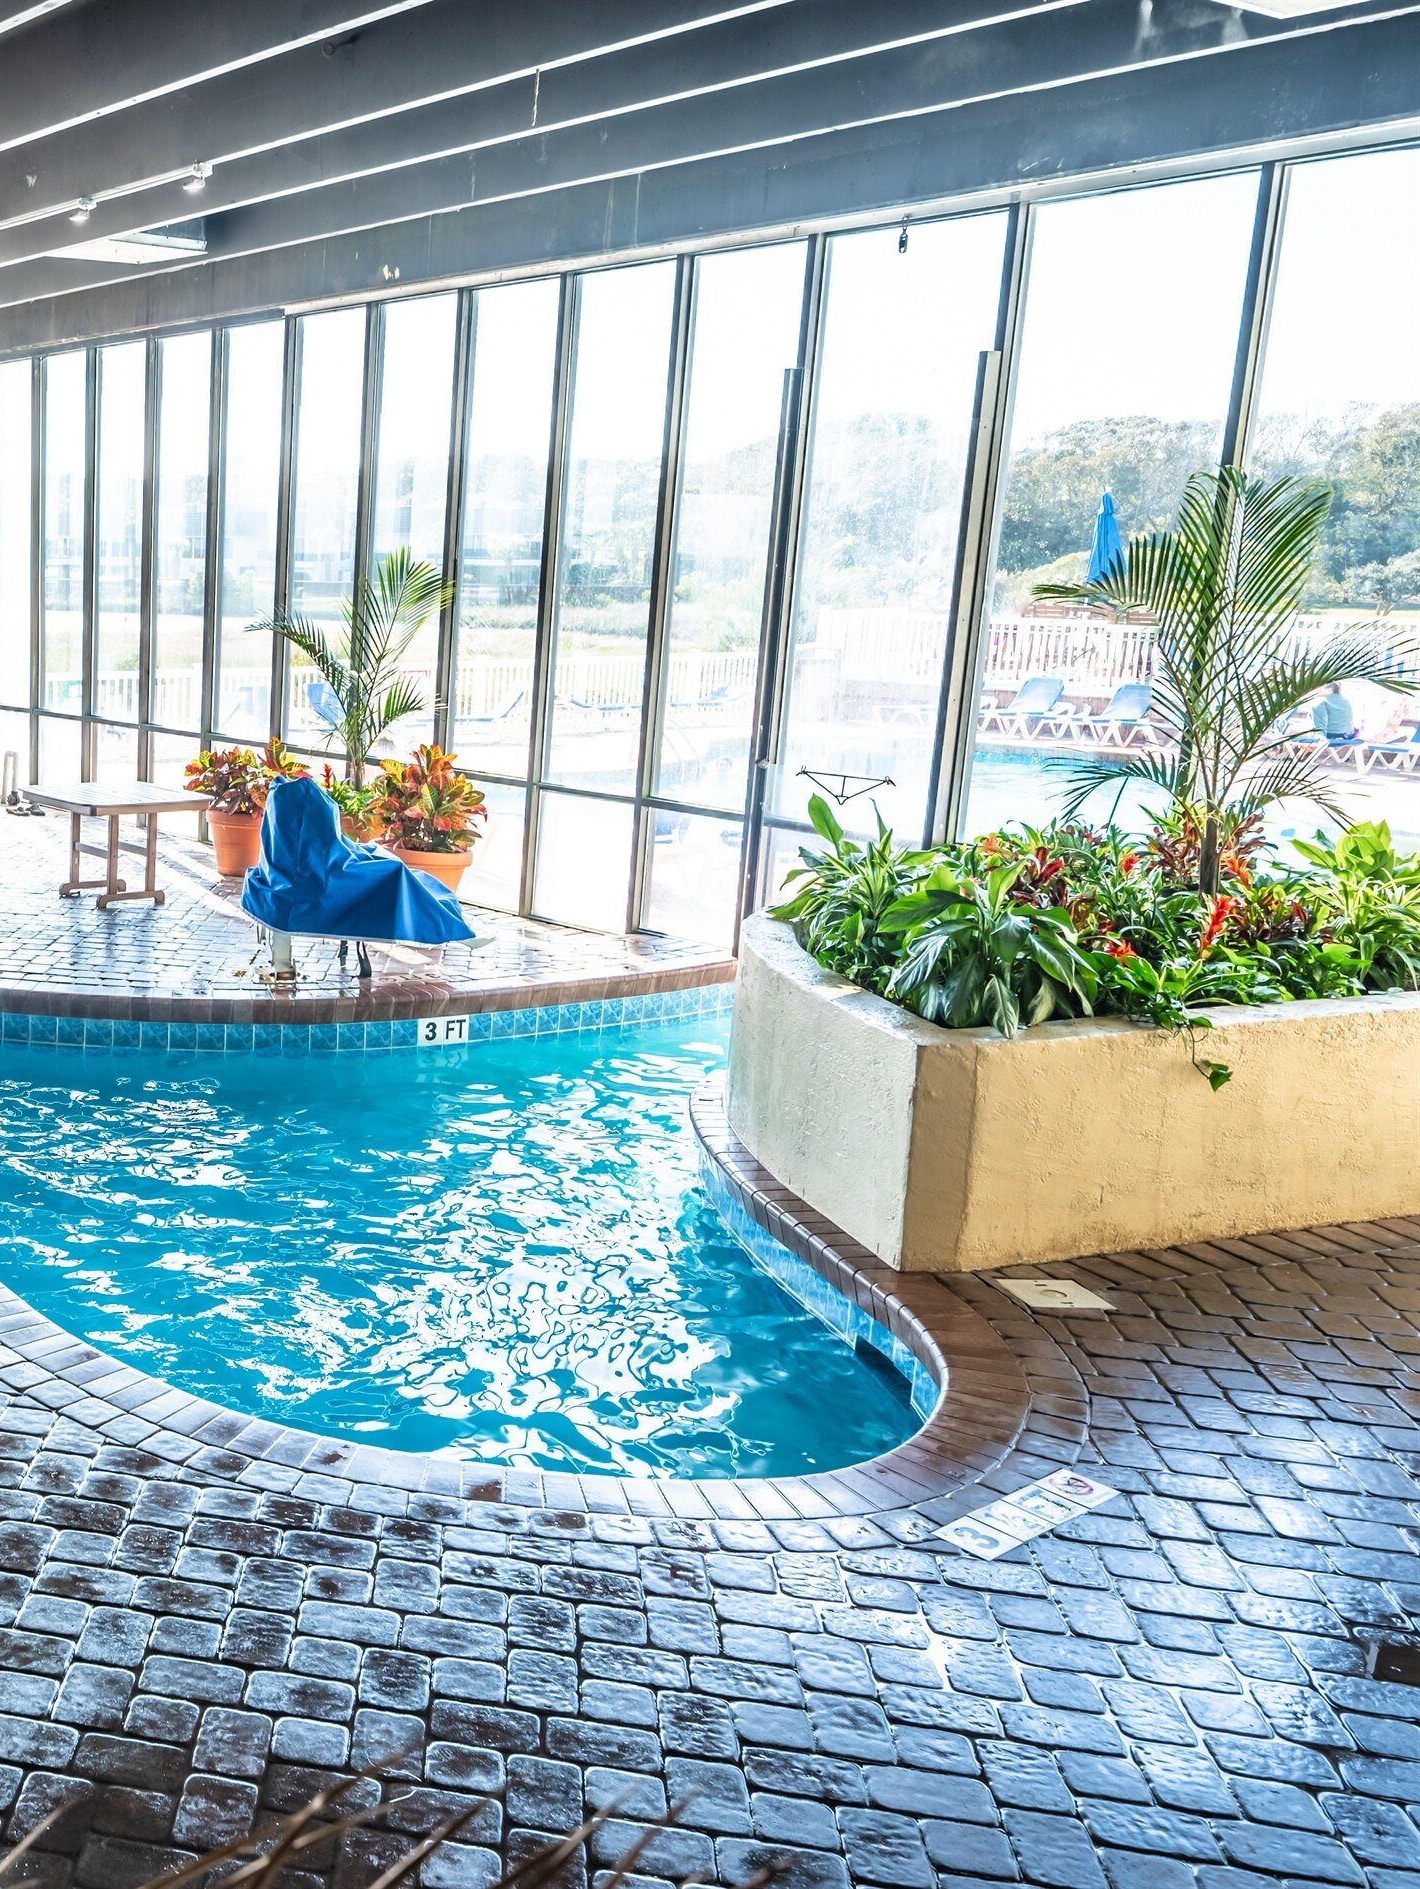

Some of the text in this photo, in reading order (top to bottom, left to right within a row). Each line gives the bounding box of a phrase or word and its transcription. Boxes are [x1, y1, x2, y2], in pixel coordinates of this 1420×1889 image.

[425, 1019, 466, 1041] 3 FT
[953, 1526, 1000, 1549] 3
[1013, 1488, 1072, 1518] FT
